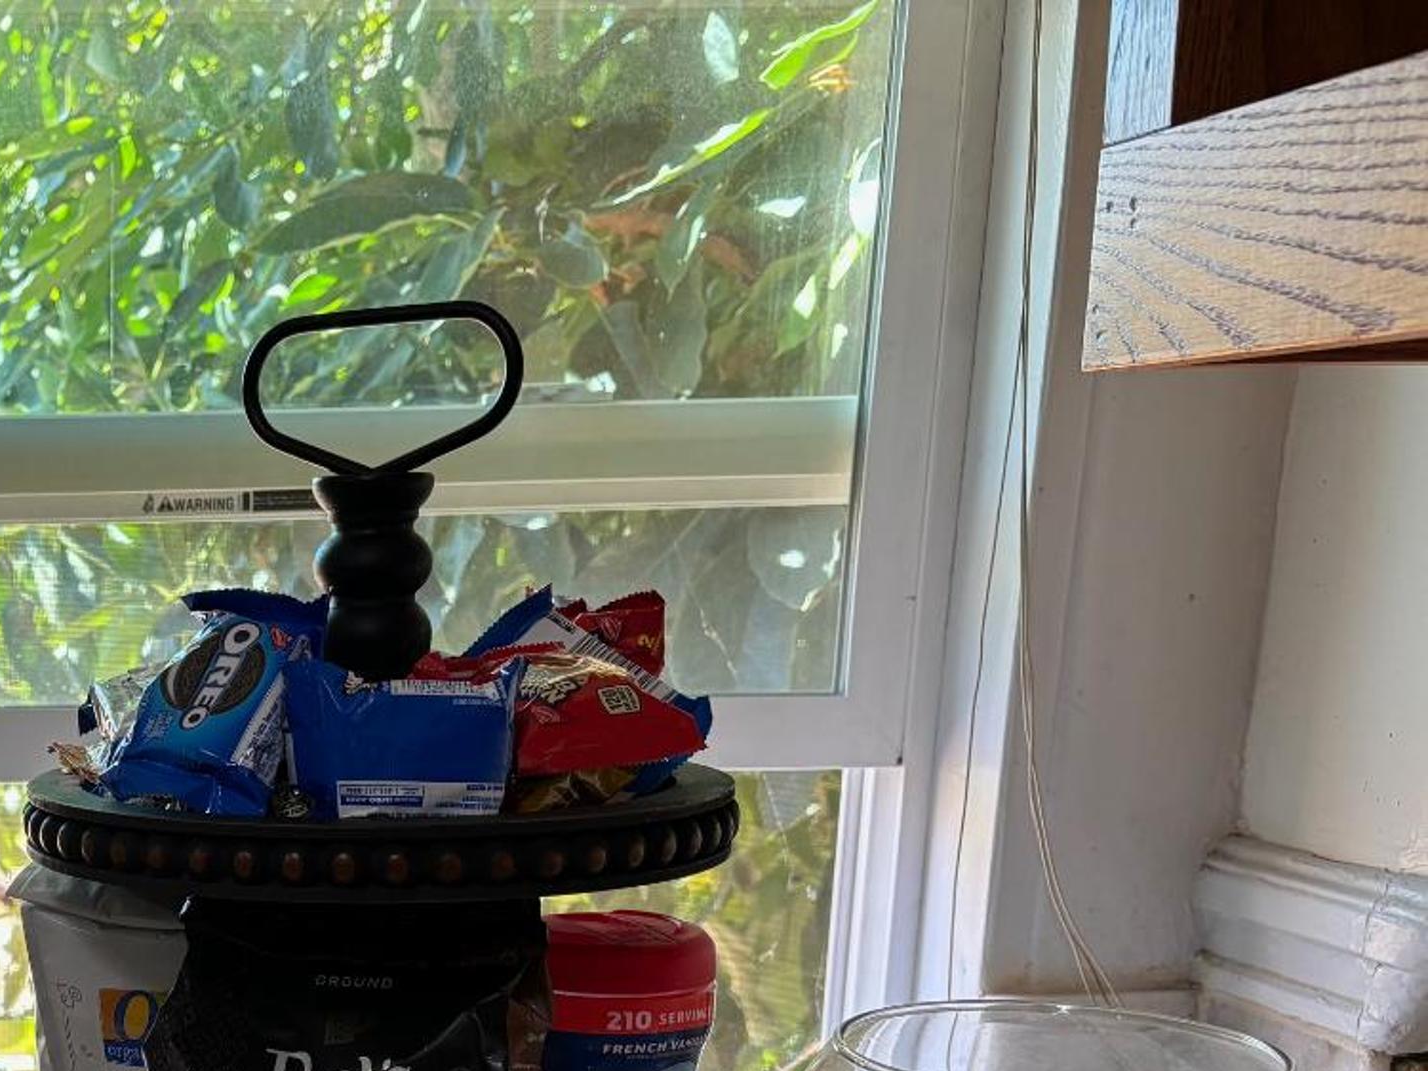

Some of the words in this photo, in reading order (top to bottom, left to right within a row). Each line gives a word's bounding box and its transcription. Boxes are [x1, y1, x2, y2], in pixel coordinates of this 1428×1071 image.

[172, 496, 235, 511] WARNING
[180, 621, 262, 731] OREO
[315, 974, 394, 990] GROUND
[605, 1010, 653, 1031] 210
[602, 1041, 667, 1056] FRENCH
